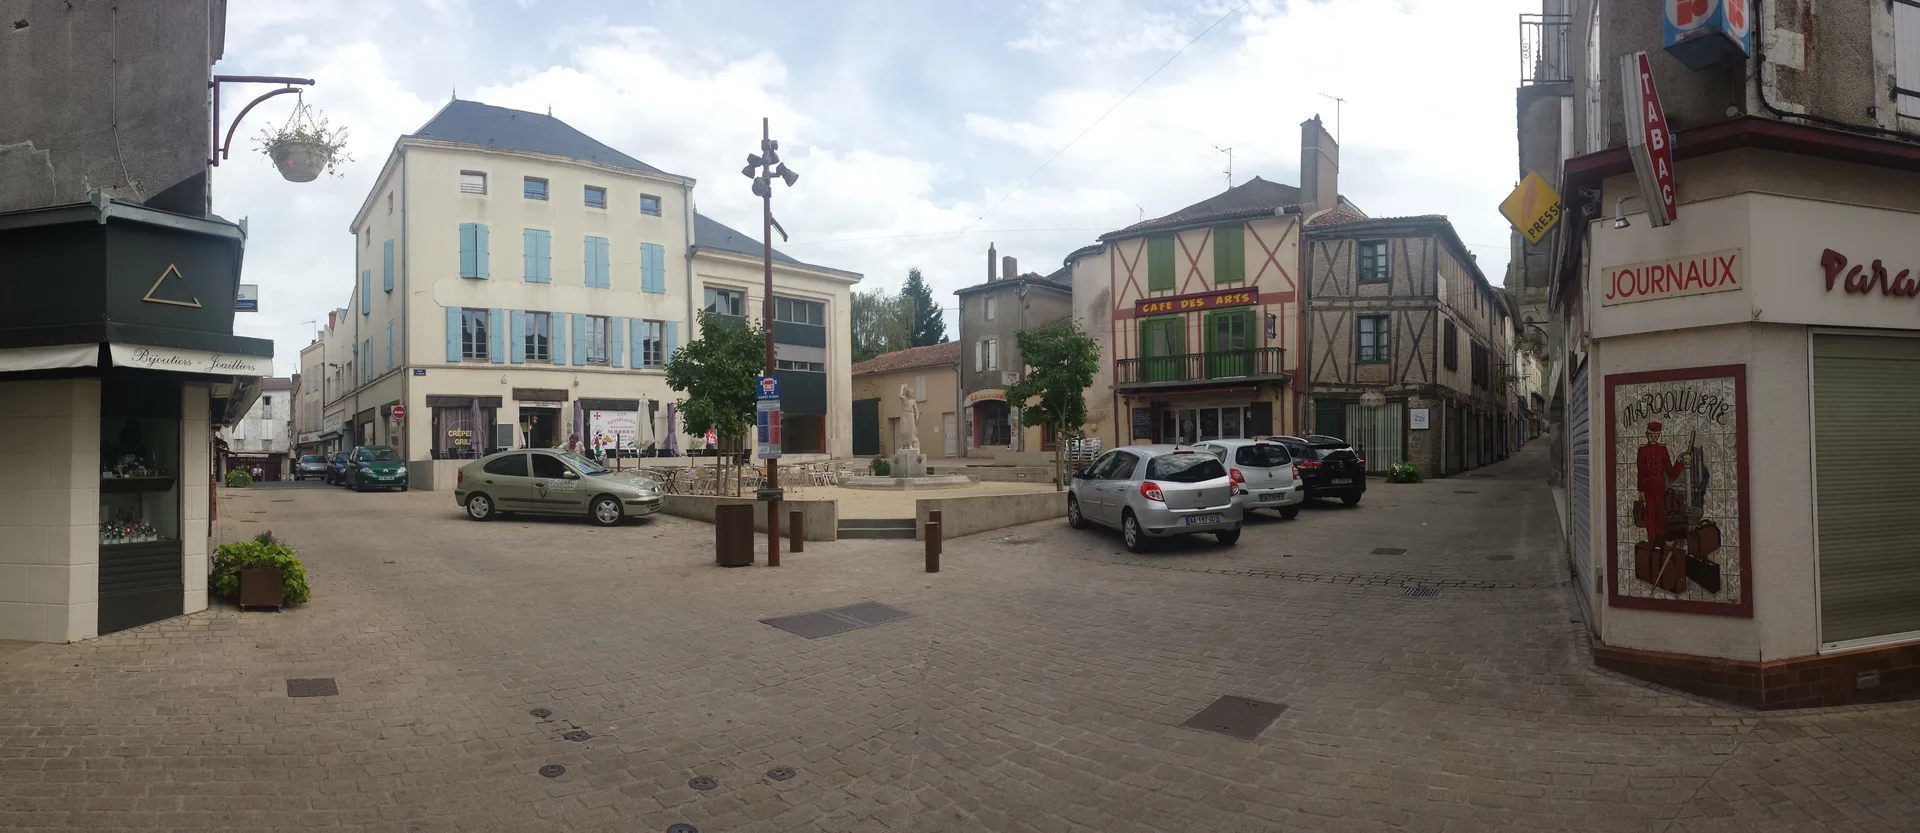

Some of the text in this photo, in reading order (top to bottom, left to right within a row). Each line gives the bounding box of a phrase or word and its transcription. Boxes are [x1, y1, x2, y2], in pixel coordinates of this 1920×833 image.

[1641, 73, 1673, 205] TABAC
[1605, 254, 1737, 300] JOURNAUX
[1821, 248, 1920, 297] Para
[1142, 293, 1250, 313] CAFE DES ARTS
[132, 347, 192, 367] Bijoutiers
[204, 354, 256, 372] Joailliers
